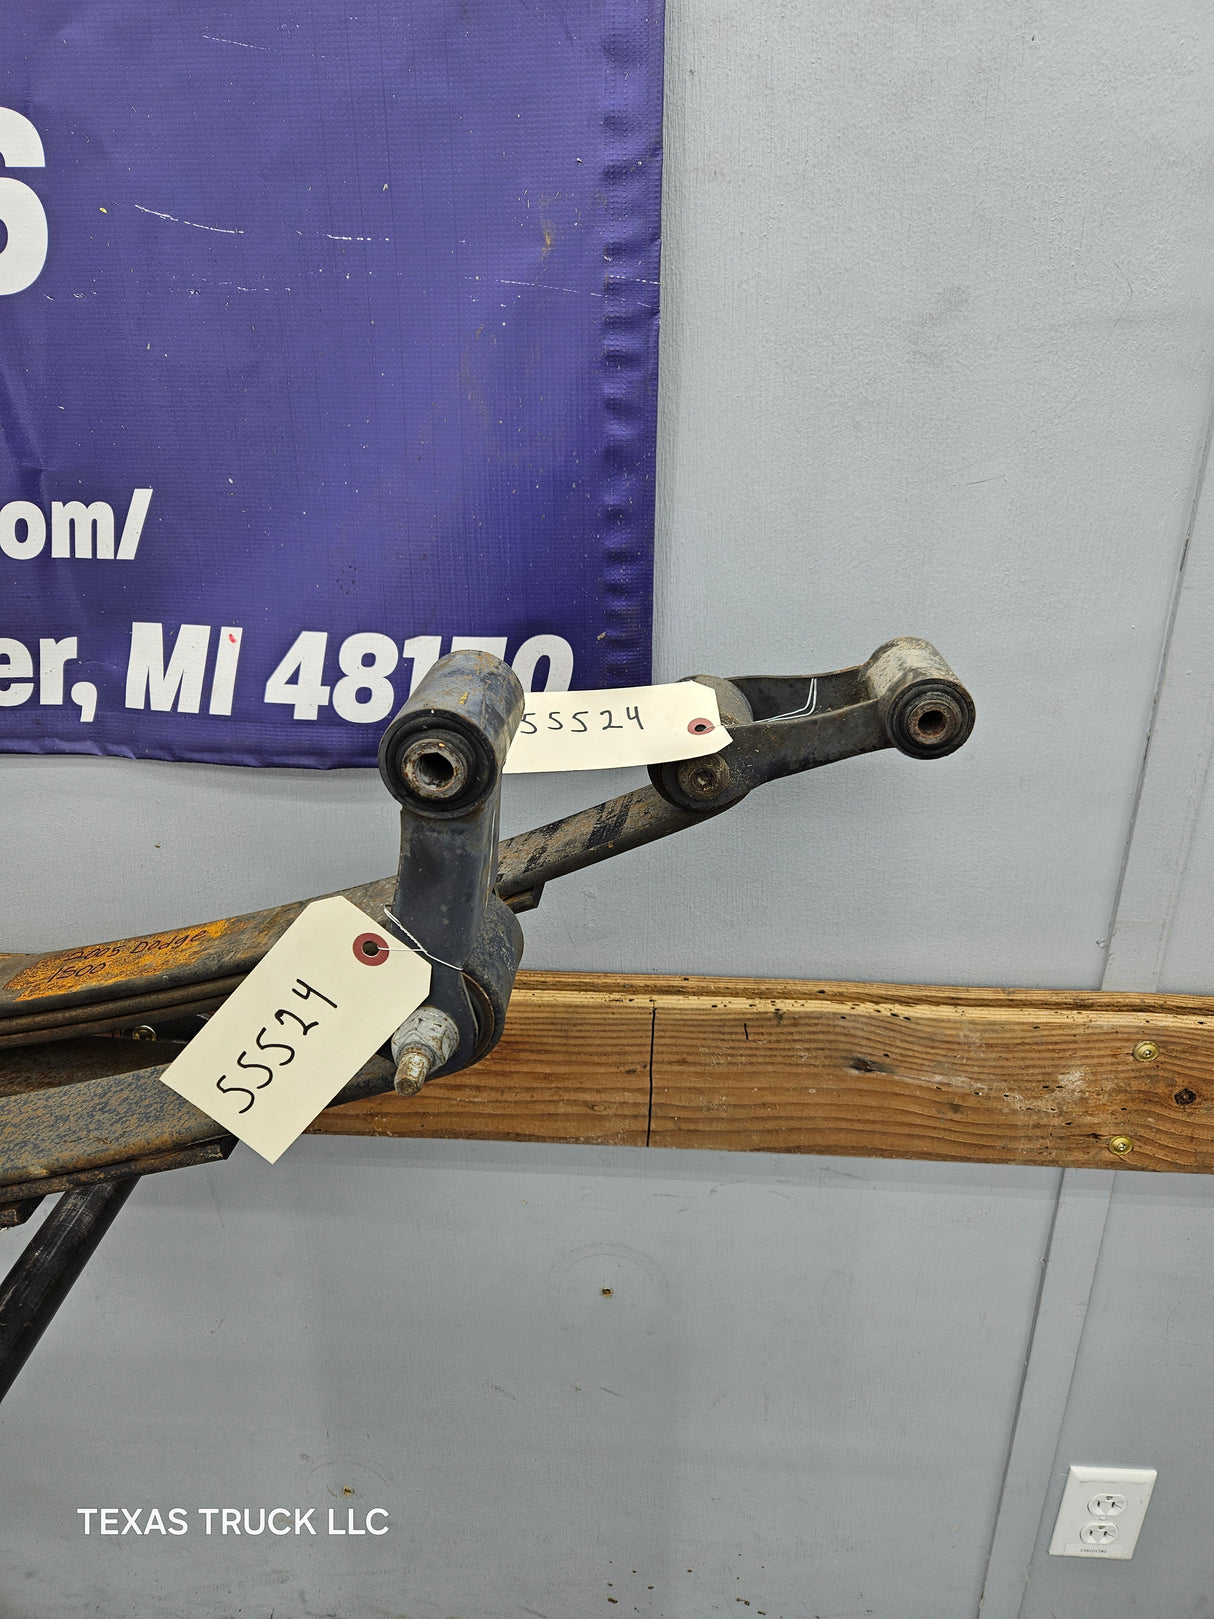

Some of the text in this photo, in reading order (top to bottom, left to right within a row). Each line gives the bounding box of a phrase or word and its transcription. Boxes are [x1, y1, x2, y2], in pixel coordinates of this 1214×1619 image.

[125, 621, 242, 716] MI
[520, 706, 644, 734] 55524
[64, 929, 207, 962] 2005 Dodge
[47, 962, 107, 983] 1500
[216, 978, 338, 1114] 55524
